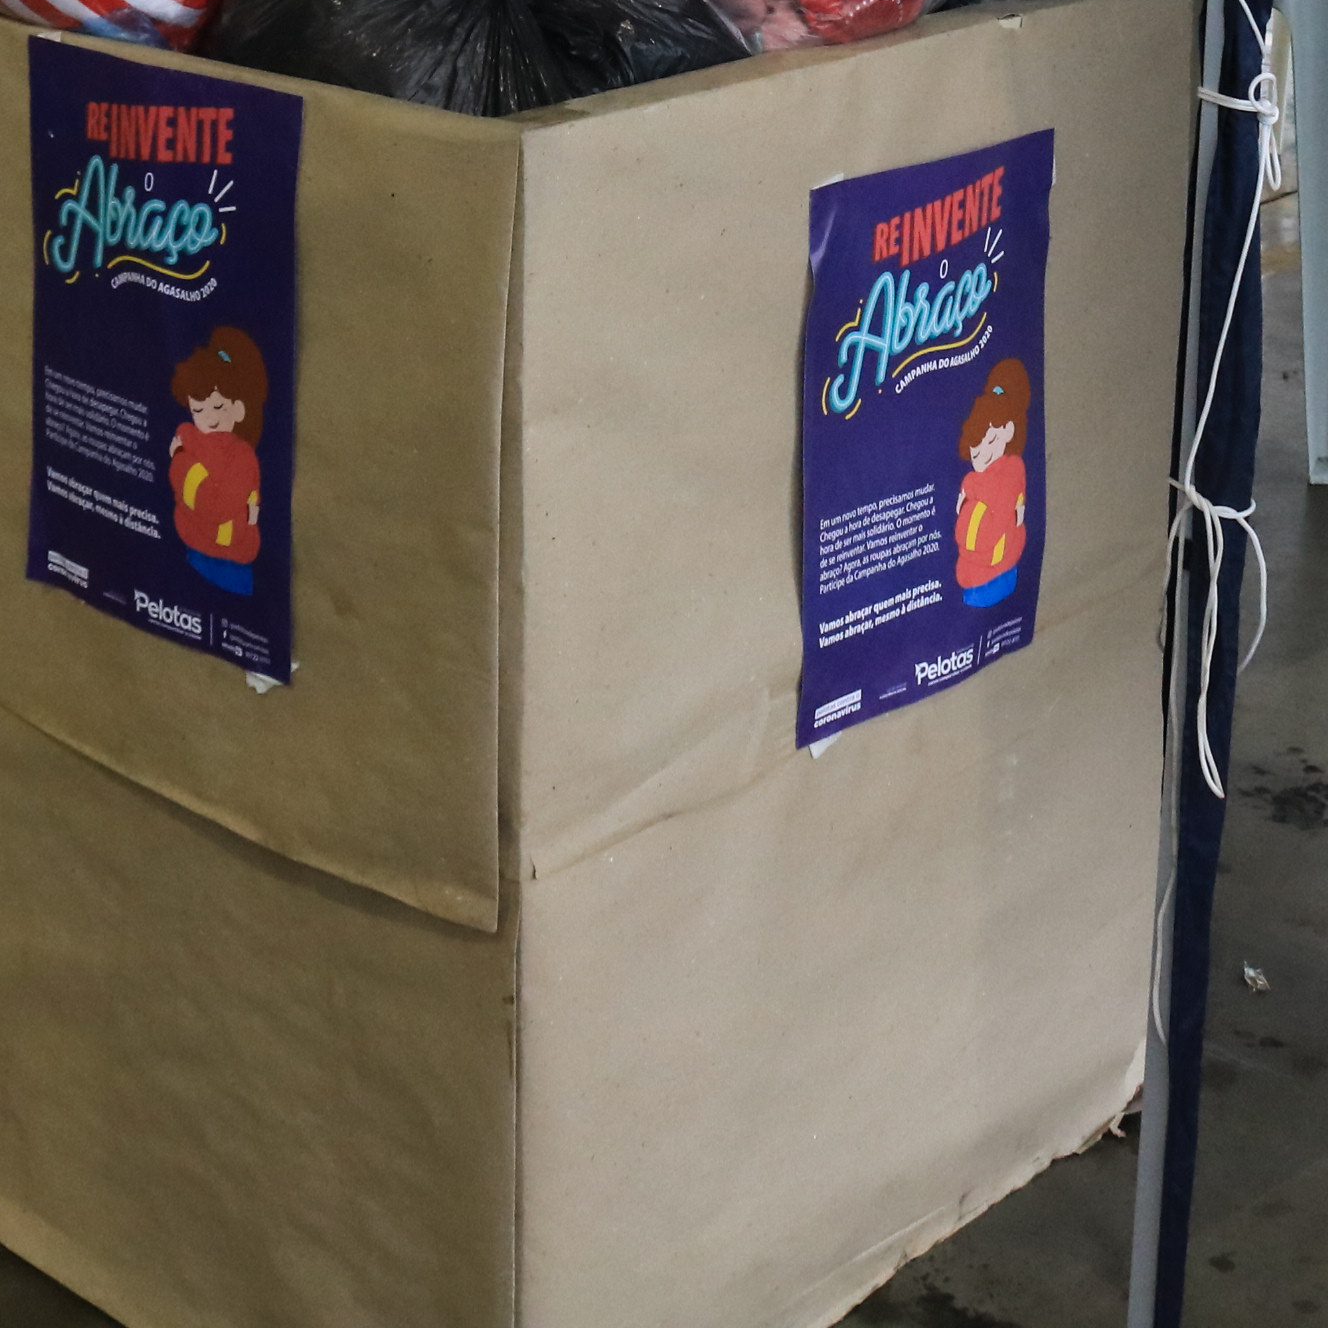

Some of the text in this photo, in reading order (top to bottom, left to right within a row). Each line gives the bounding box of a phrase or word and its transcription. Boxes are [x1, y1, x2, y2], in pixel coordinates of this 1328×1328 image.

[85, 101, 235, 165] REINVENTE
[51, 154, 220, 273] Abraço
[873, 165, 1006, 268] REINVENTE
[111, 271, 218, 302] CAMPANHA DO AGASALHO 2020
[829, 262, 993, 413] Abraço
[895, 325, 993, 394] CAMPANHA DO AGASALHO 2020
[819, 519, 831, 530] Em
[830, 515, 842, 526] um
[842, 509, 857, 522] novo
[878, 490, 914, 511] precisamos
[819, 528, 844, 543] Chegou
[848, 519, 862, 532] hora
[862, 515, 871, 526] de
[906, 498, 929, 513] Chegou
[819, 542, 834, 556] hora
[834, 539, 843, 551] de
[843, 536, 852, 548] ser
[852, 530, 866, 543] mais
[902, 508, 931, 527] momento
[819, 557, 828, 569] de
[828, 555, 836, 565] se
[866, 535, 888, 551] Vamos
[888, 525, 918, 544] reinventar
[862, 554, 870, 565] as
[870, 548, 892, 562] roupas
[892, 538, 917, 554] abraçam
[917, 534, 929, 547] por
[819, 577, 845, 595] Participe
[846, 574, 854, 584] da
[854, 561, 887, 579] Campanha
[887, 558, 897, 569] do
[896, 548, 922, 567] Agasalho
[134, 588, 203, 635] Pelotas
[818, 580, 942, 634] Vamos abraçar quem mais precisa.
[818, 592, 943, 649] Vamos abraçar, mesmo à distância.
[915, 648, 974, 685] Pelotas
[813, 701, 862, 729] coronavírus
